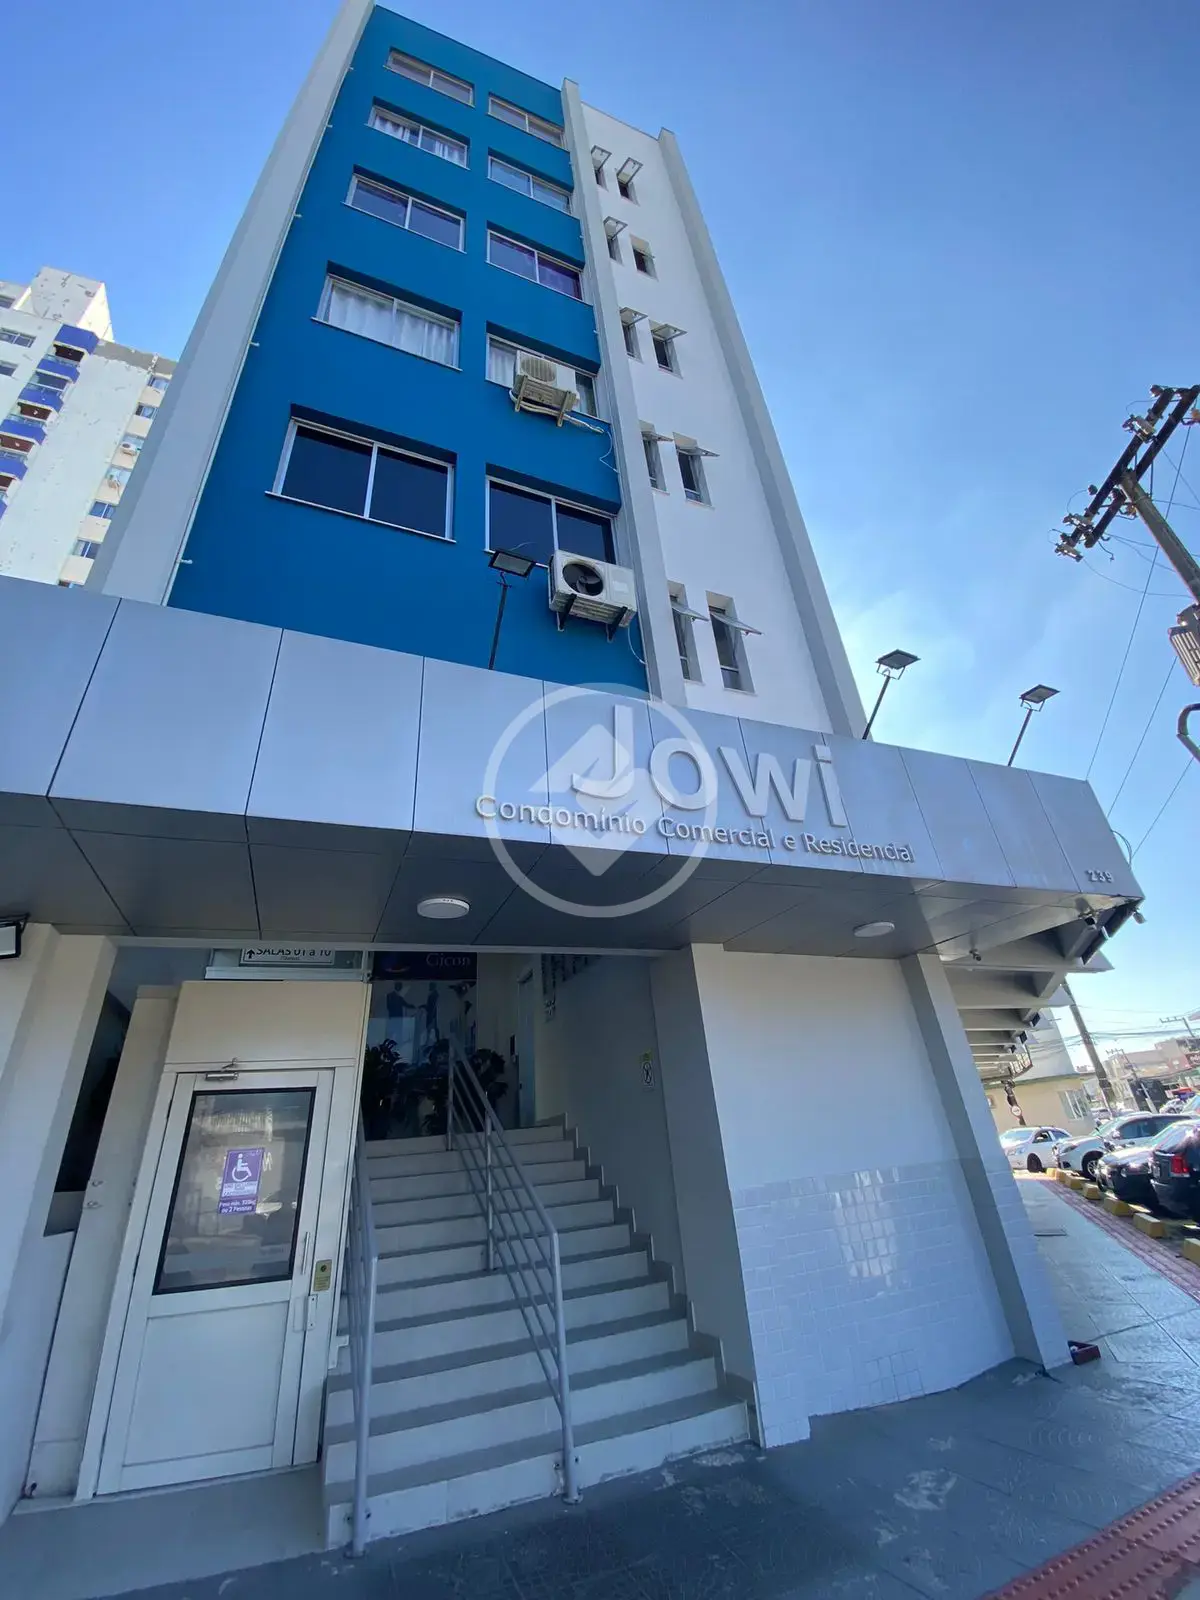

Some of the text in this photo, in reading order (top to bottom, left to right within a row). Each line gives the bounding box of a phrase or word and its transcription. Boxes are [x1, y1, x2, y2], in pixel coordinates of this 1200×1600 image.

[571, 704, 847, 828] Jowi
[476, 794, 915, 862] Condomínio Comercial e Residencial
